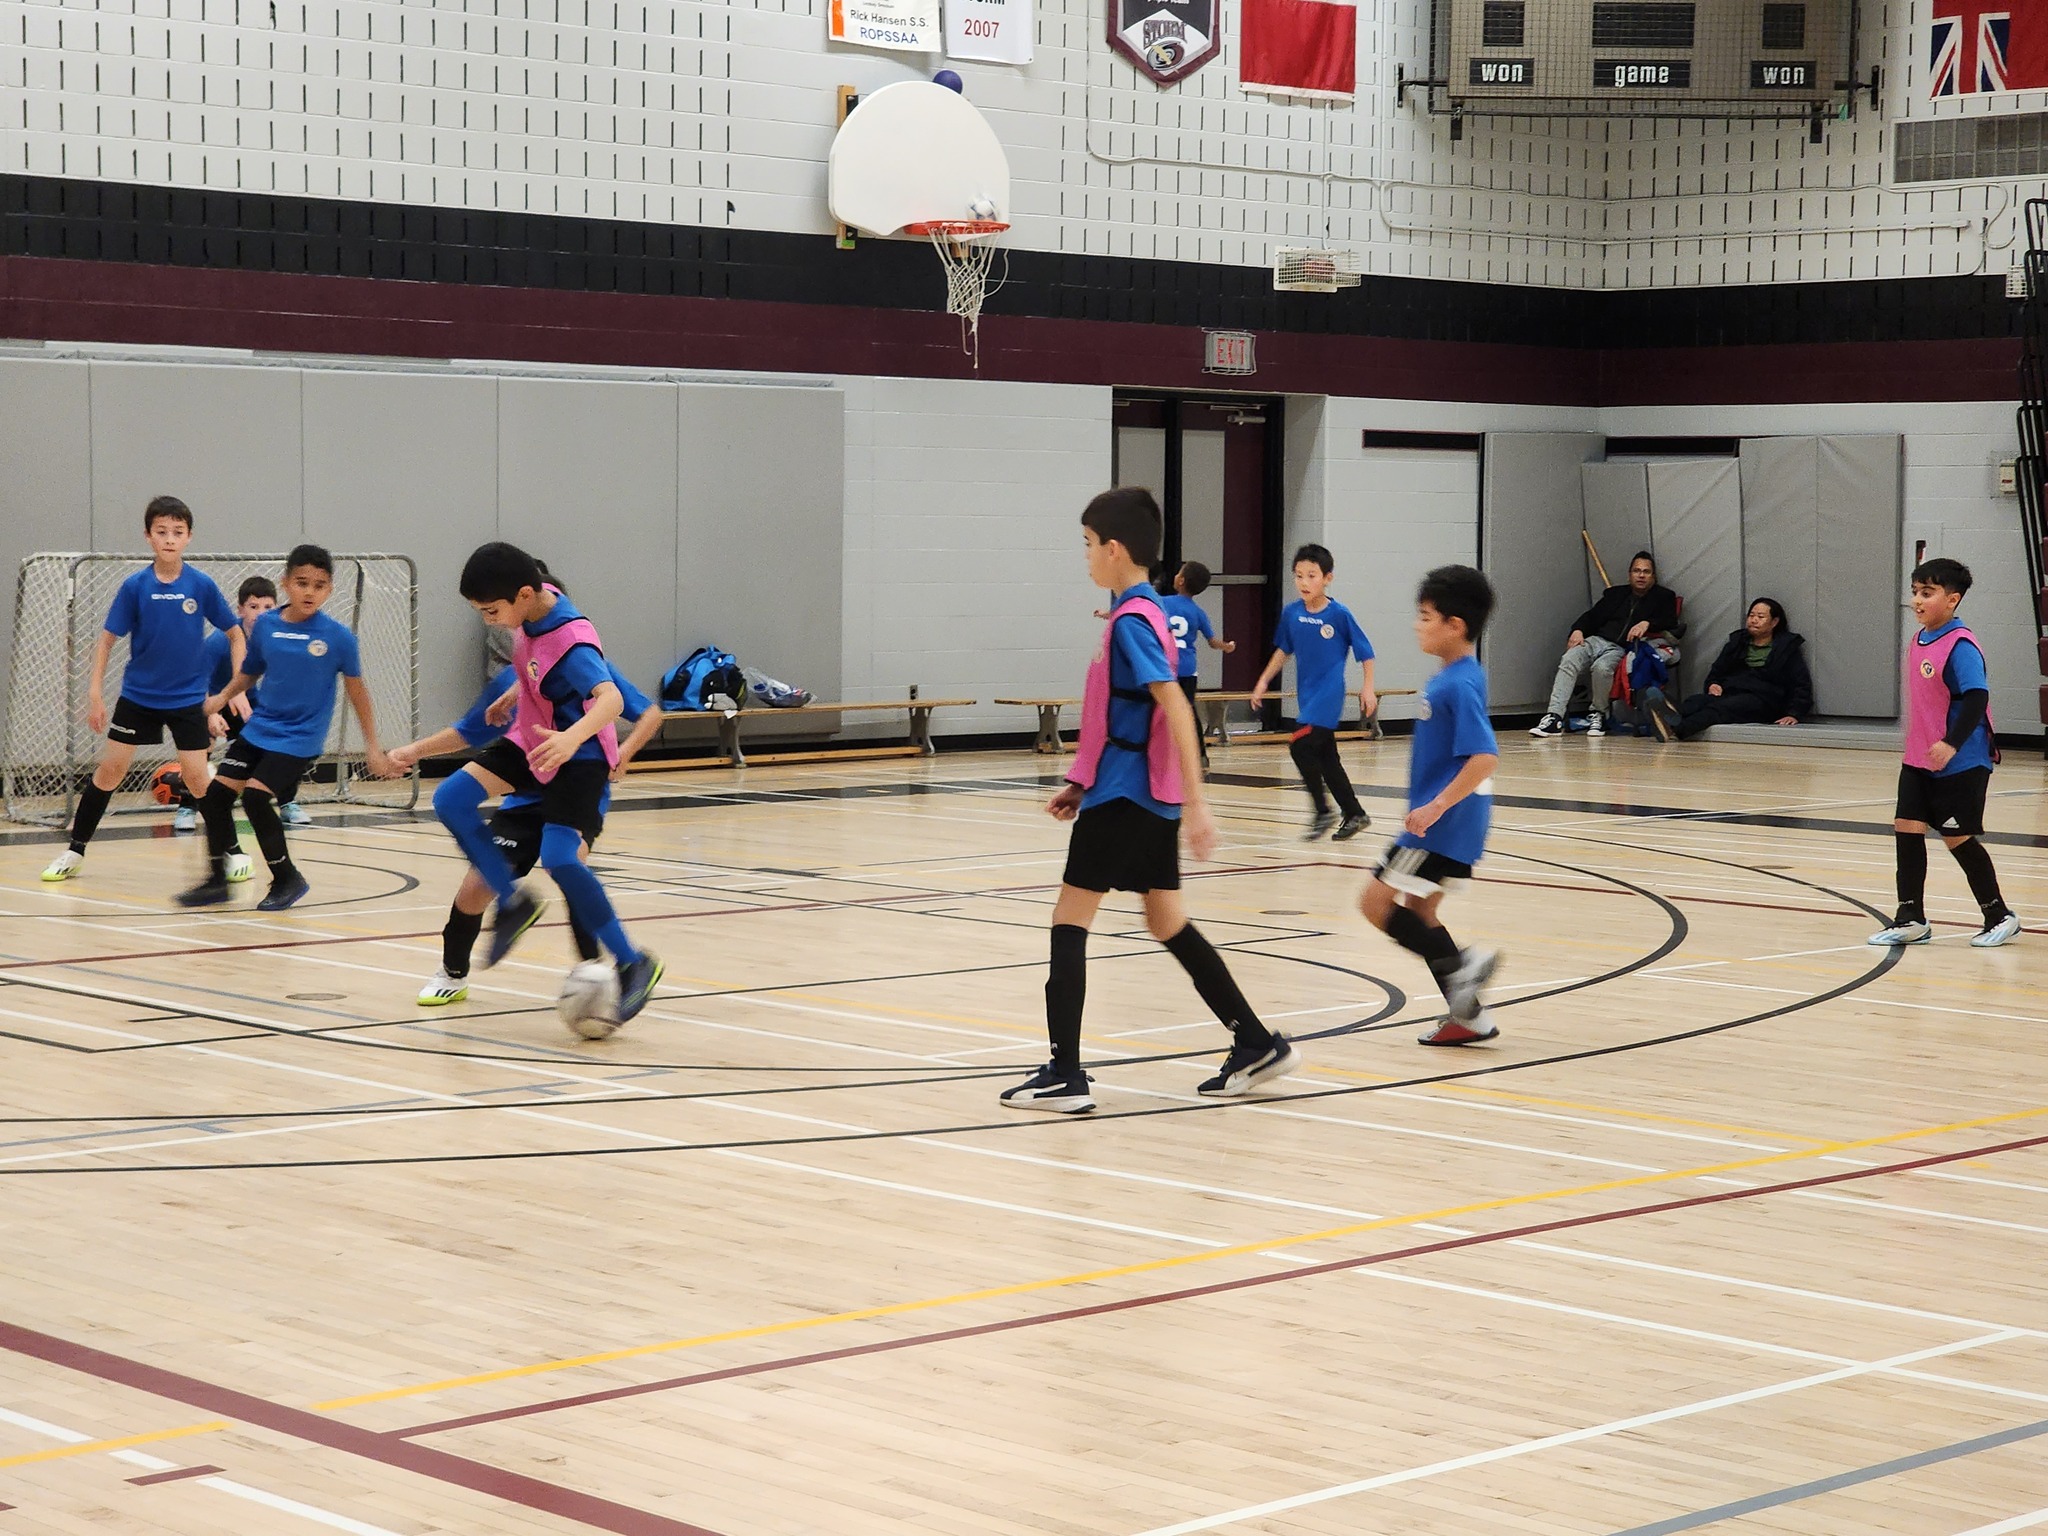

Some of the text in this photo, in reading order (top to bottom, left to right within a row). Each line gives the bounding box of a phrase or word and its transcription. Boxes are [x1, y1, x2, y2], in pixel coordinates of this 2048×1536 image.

[850, 9, 929, 28] Rick Hansen S.S.
[964, 18, 1000, 38] 2007
[860, 27, 919, 44] ROPSSAA
[1481, 63, 1523, 82] won
[1614, 65, 1669, 87] game
[1762, 66, 1805, 85] won
